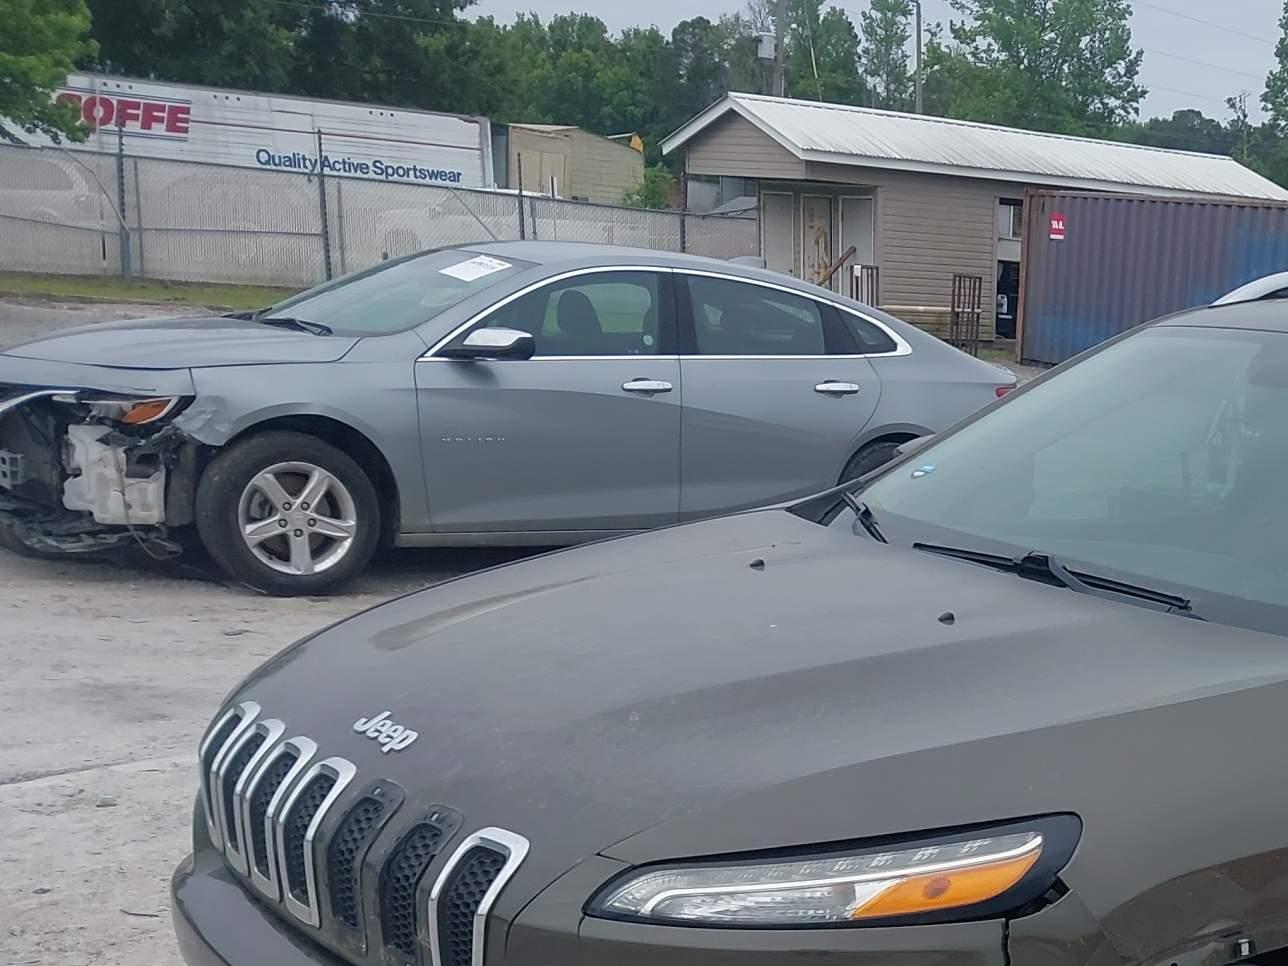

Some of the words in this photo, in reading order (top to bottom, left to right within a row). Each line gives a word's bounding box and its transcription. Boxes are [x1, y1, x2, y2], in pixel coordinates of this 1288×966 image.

[255, 148, 318, 173] Quality
[320, 154, 371, 175] Active
[371, 159, 463, 184] Sportswear
[352, 710, 419, 753] Jeep
